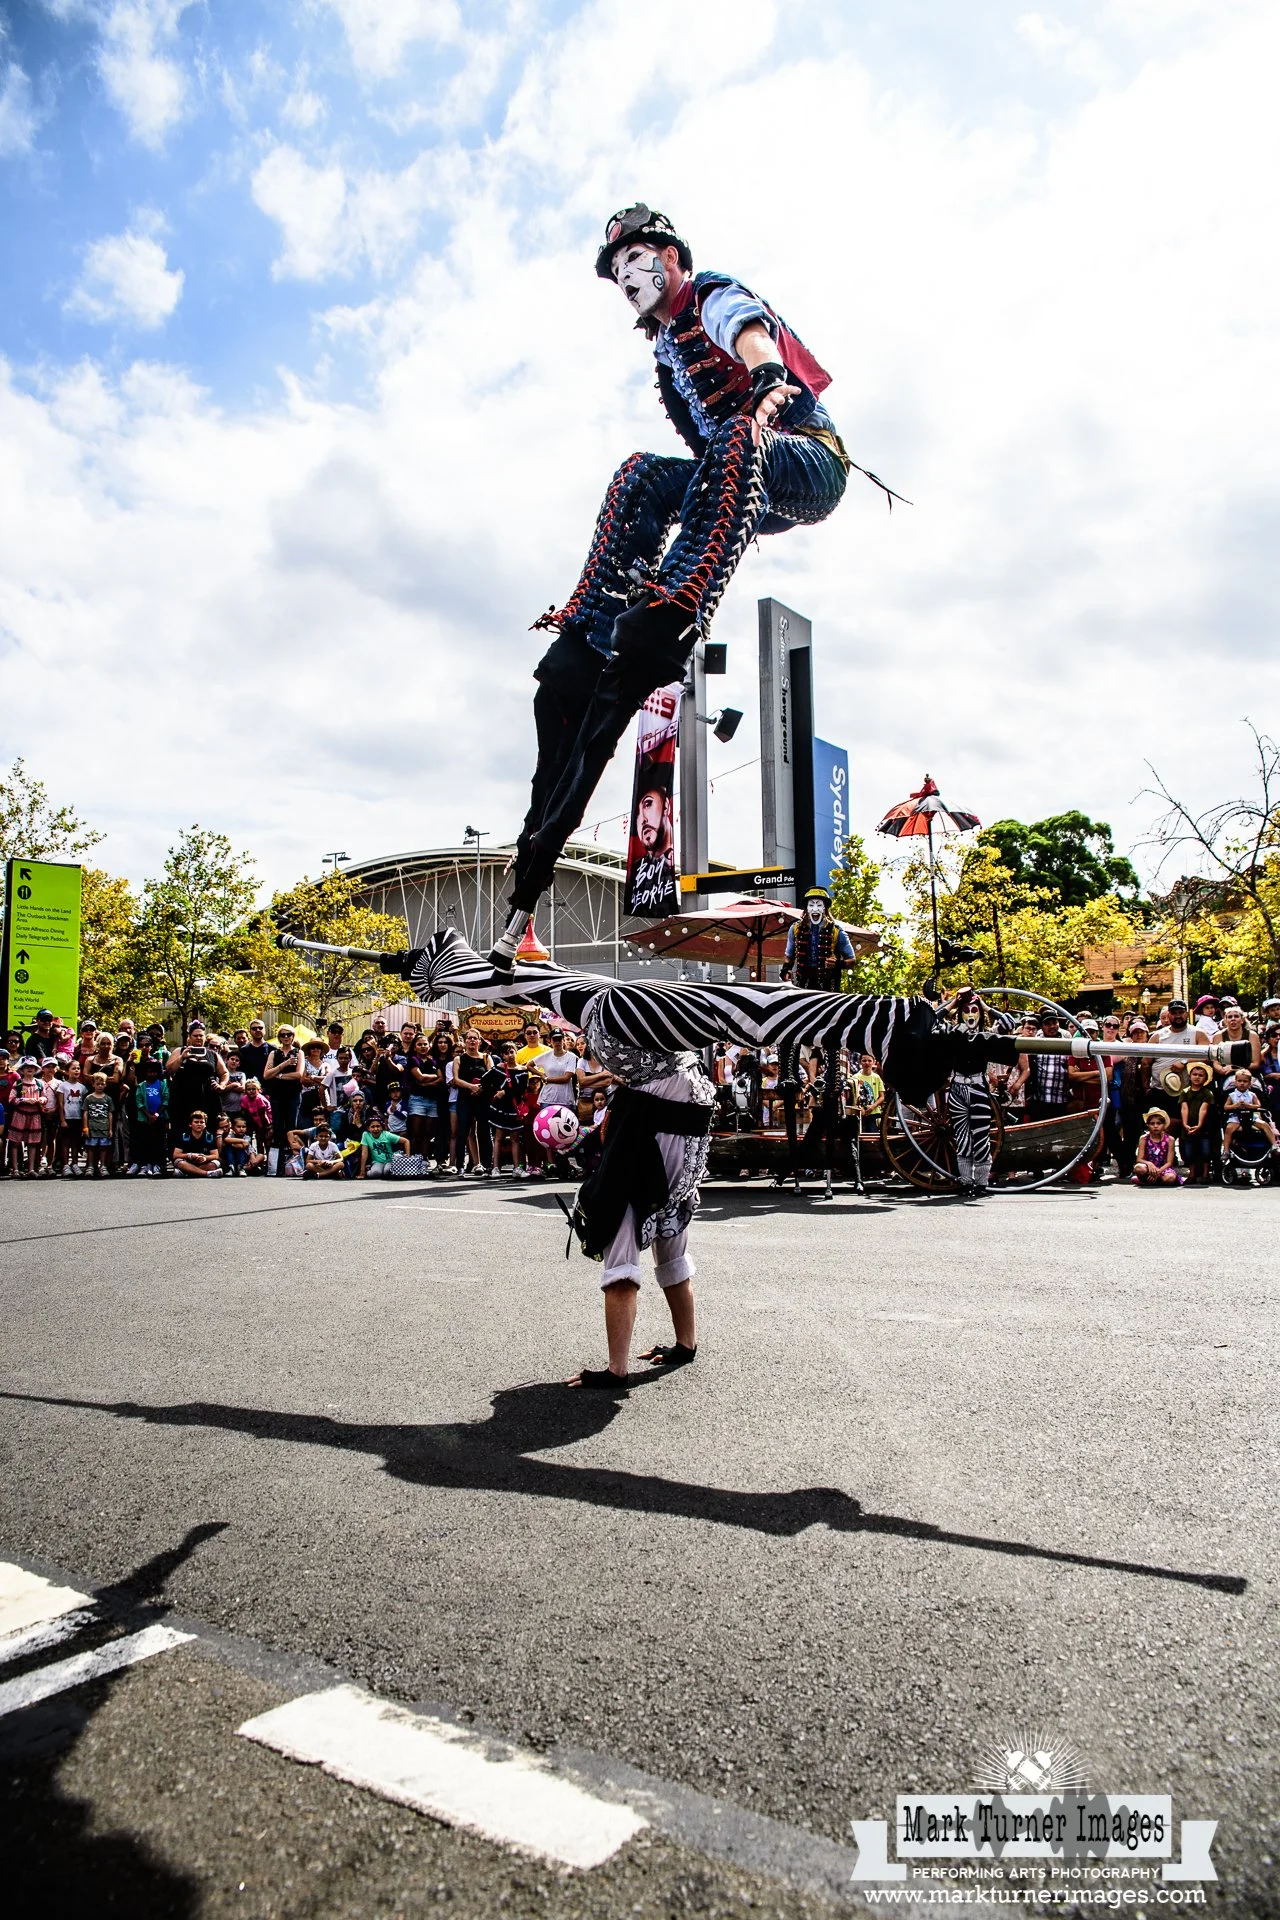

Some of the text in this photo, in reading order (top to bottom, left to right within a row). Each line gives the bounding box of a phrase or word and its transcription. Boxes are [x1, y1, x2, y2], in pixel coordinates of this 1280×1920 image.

[779, 616, 790, 764] Sydney Showground
[829, 764, 846, 870] Sydney
[635, 857, 666, 889] BOY
[753, 873, 783, 885] Grand
